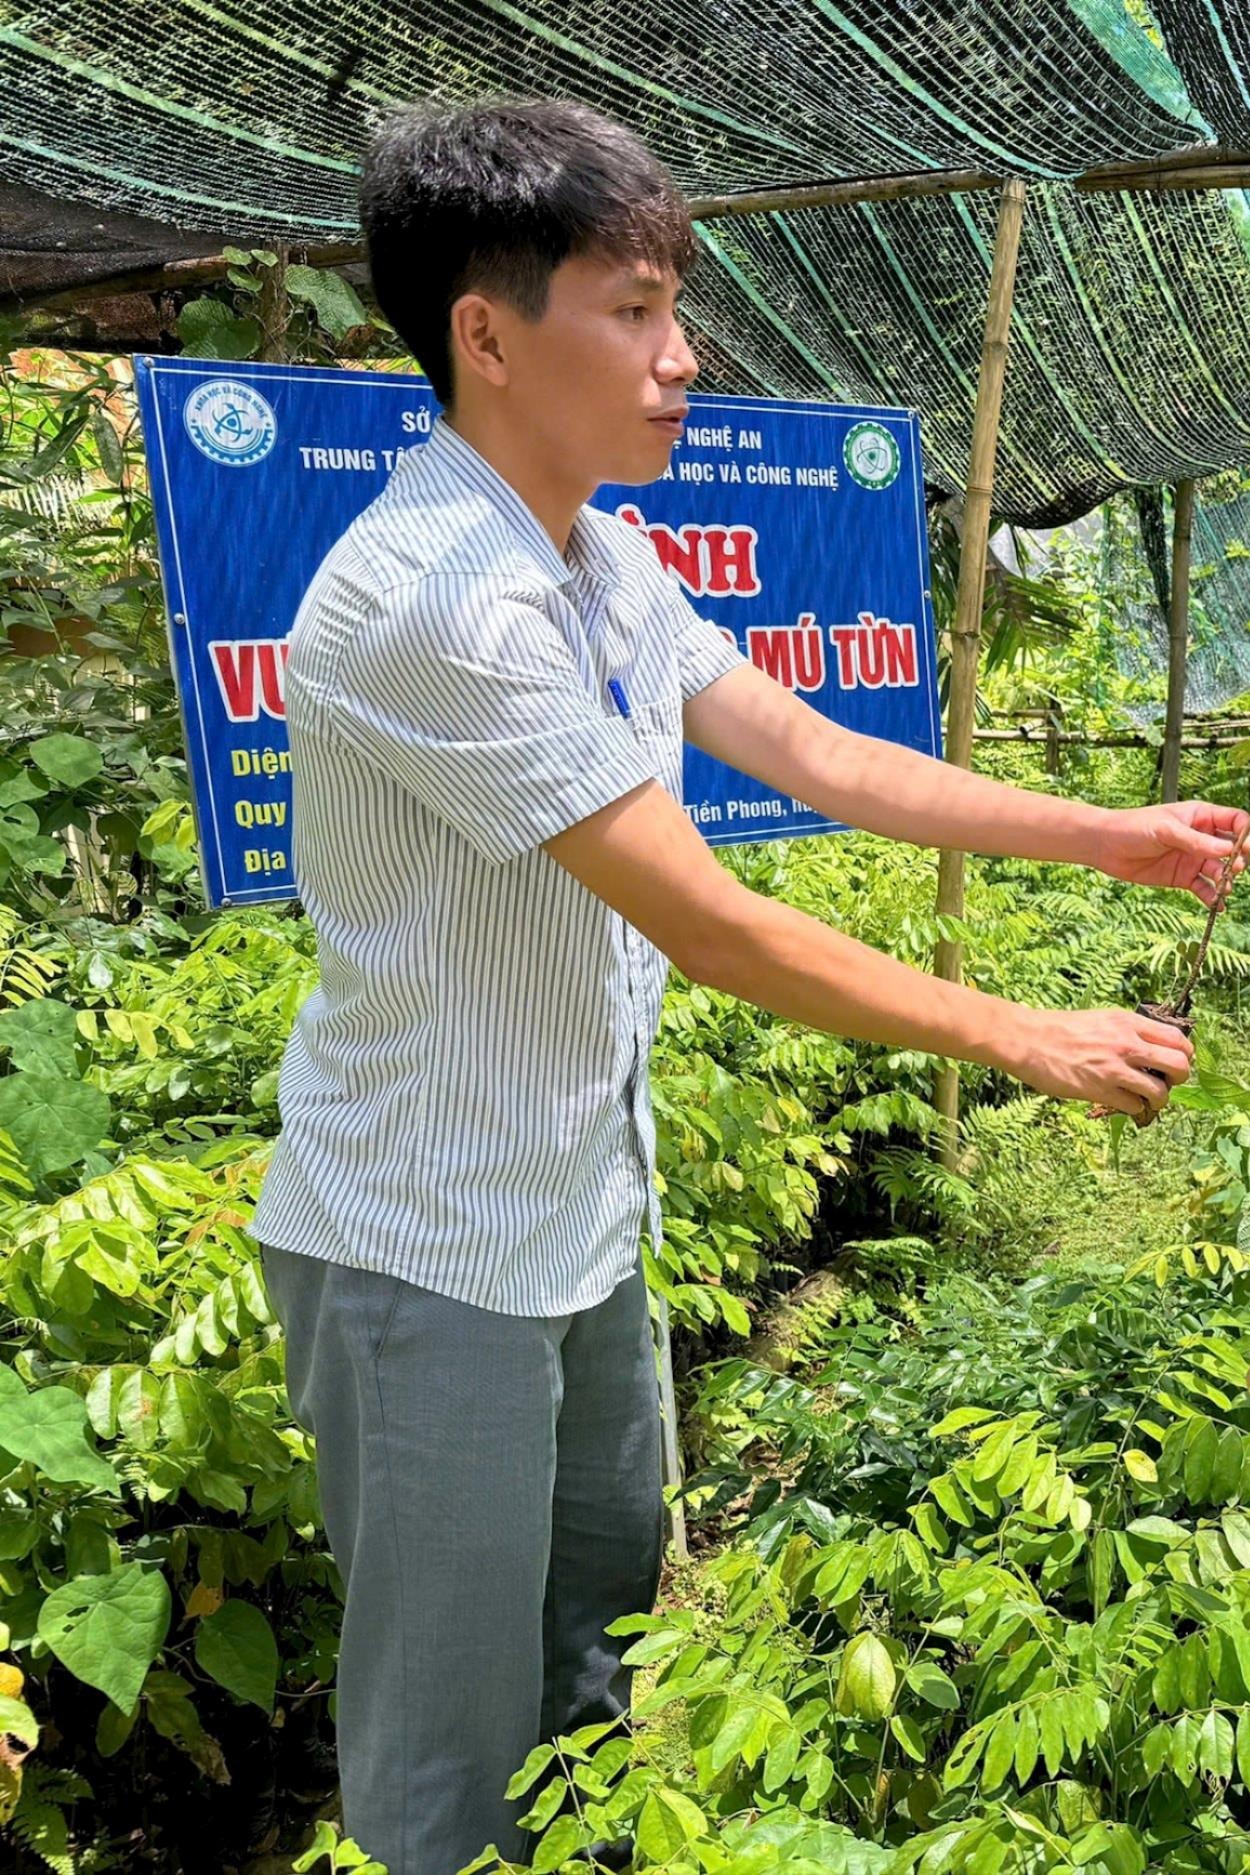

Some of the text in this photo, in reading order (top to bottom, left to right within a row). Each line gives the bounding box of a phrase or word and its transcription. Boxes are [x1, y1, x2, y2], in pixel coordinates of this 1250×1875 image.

[401, 405, 762, 452] SỞ NGHỆ AN
[299, 447, 376, 471] TRUNG
[679, 462, 714, 485] HỌC
[718, 460, 741, 483] VÀ
[746, 462, 792, 485] CÔNG
[796, 465, 839, 491] NGHỆ
[746, 611, 825, 692] MÚ
[829, 611, 919, 690] TỪN
[235, 800, 287, 829] Quy
[244, 849, 287, 876] Địa
[683, 799, 722, 824] Tiền
[727, 799, 788, 821] Phong,
